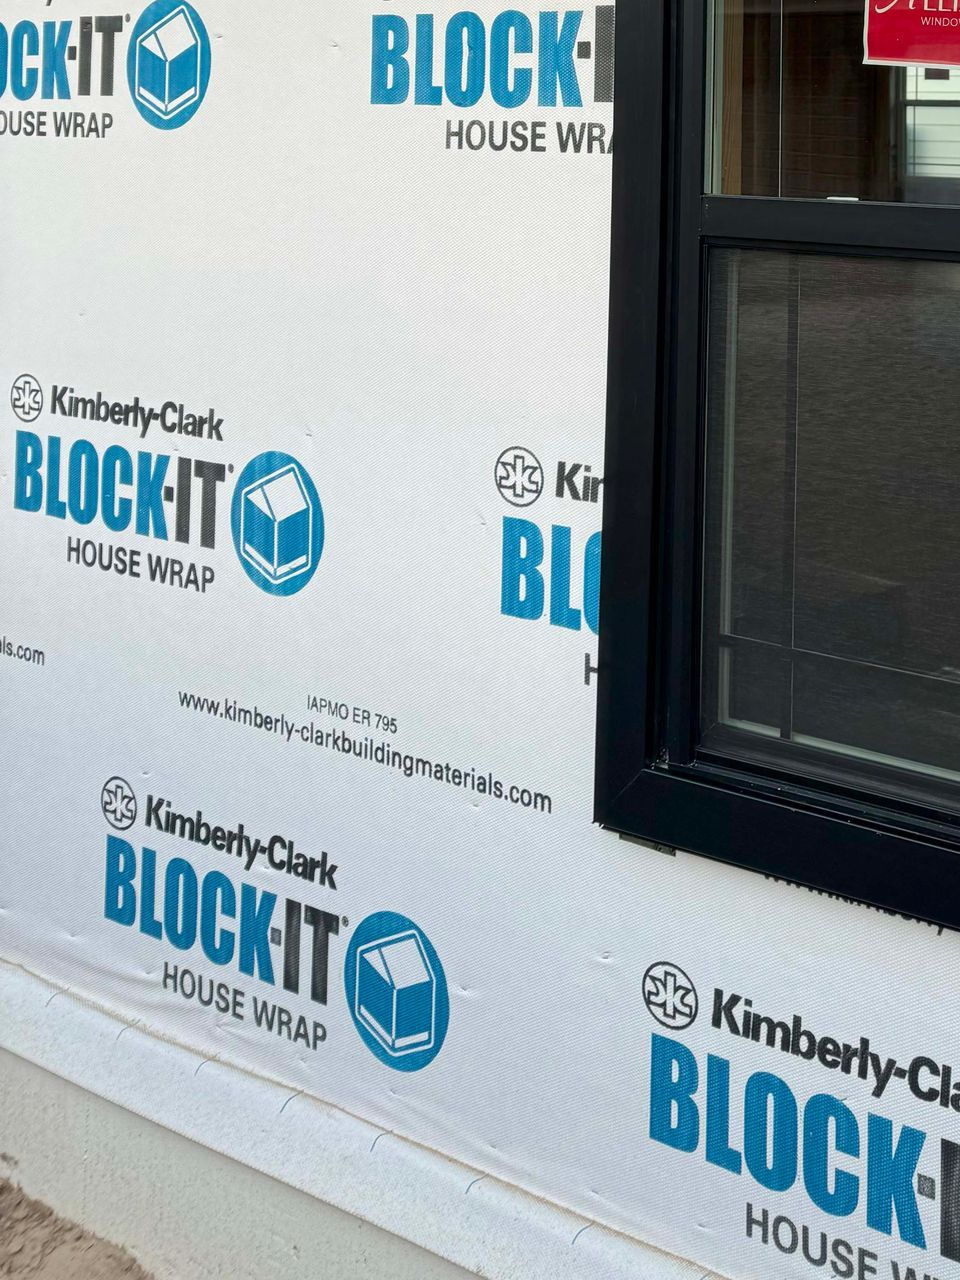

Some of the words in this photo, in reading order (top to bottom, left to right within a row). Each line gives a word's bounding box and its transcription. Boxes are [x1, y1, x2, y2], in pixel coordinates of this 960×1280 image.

[53, 112, 113, 138] WRAP
[445, 119, 547, 152] HOUSE
[50, 384, 224, 442] Kimberly-Clark
[67, 536, 141, 578] HOUSE
[148, 552, 215, 594] WRAP
[306, 694, 349, 721] IAPMO
[352, 706, 371, 728] ER
[374, 713, 398, 735] 795
[178, 690, 553, 814] www.kimberly-clarkbuildingmaterials.com
[145, 794, 338, 891] Kimberly-Clark
[162, 960, 245, 1021] HOUSE
[252, 995, 328, 1052] WRAP
[745, 1202, 878, 1280] HOUSE
